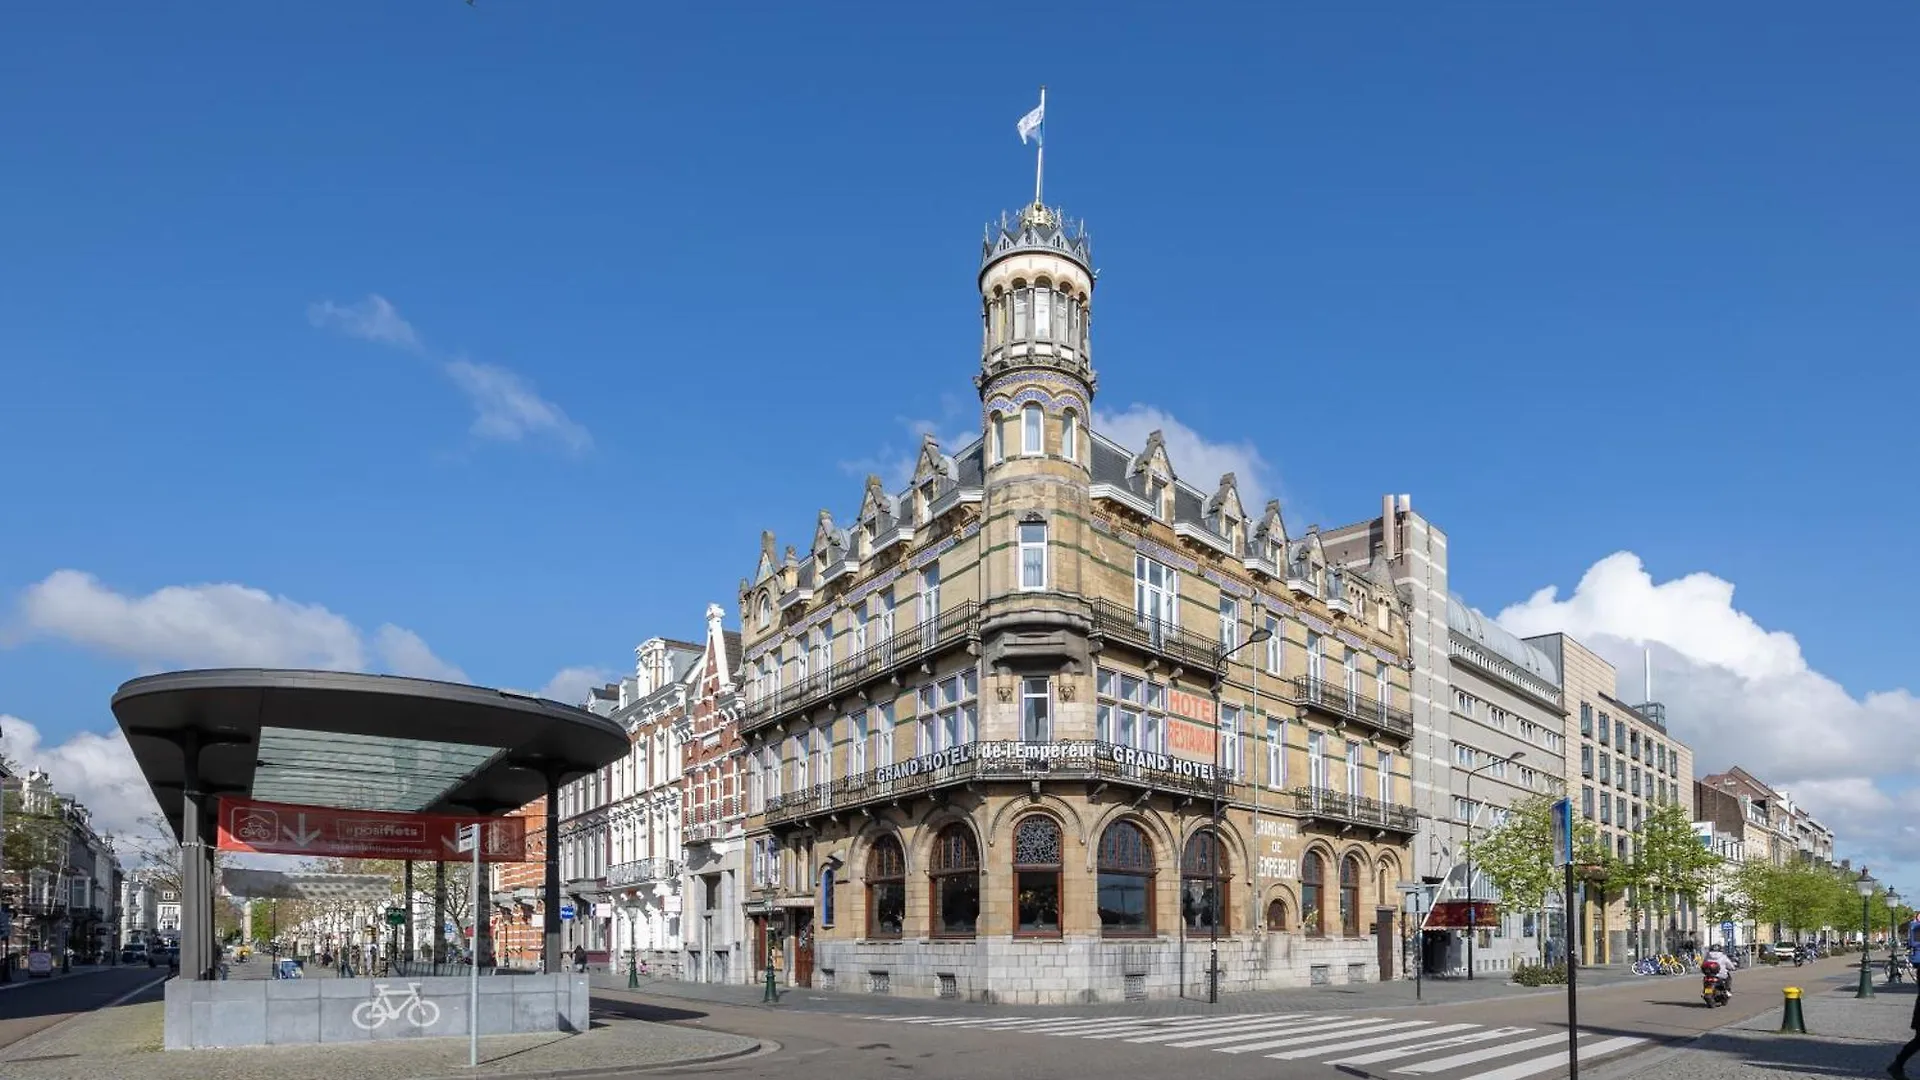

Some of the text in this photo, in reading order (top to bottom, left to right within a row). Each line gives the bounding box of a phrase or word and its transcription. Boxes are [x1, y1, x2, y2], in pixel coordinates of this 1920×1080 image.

[982, 742, 1001, 758] de
[1113, 745, 1214, 780] GRAND HOTEL
[877, 746, 968, 783] GRAND HOTEL
[1271, 840, 1282, 853] DE
